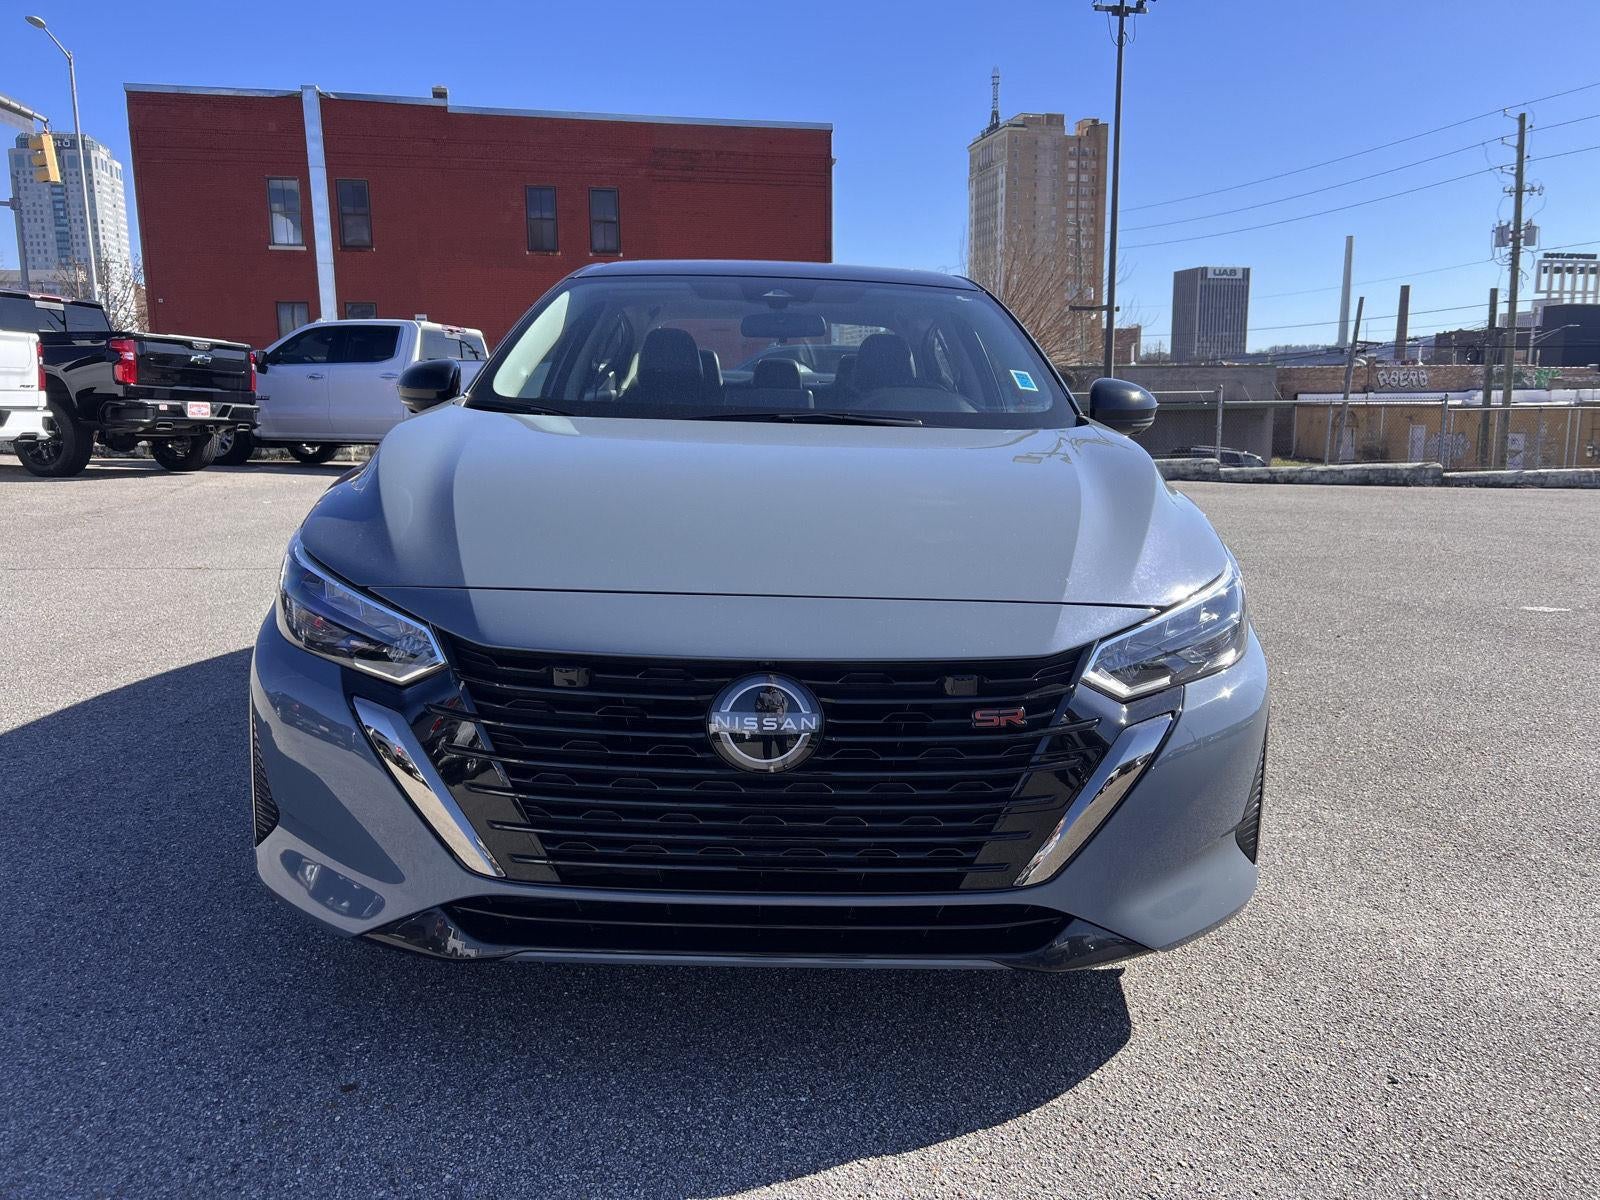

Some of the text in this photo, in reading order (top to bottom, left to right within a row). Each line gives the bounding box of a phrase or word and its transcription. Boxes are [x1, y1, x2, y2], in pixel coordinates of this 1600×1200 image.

[1213, 268, 1237, 277] UAB
[714, 714, 817, 731] NISSAN
[972, 707, 1027, 727] SR
